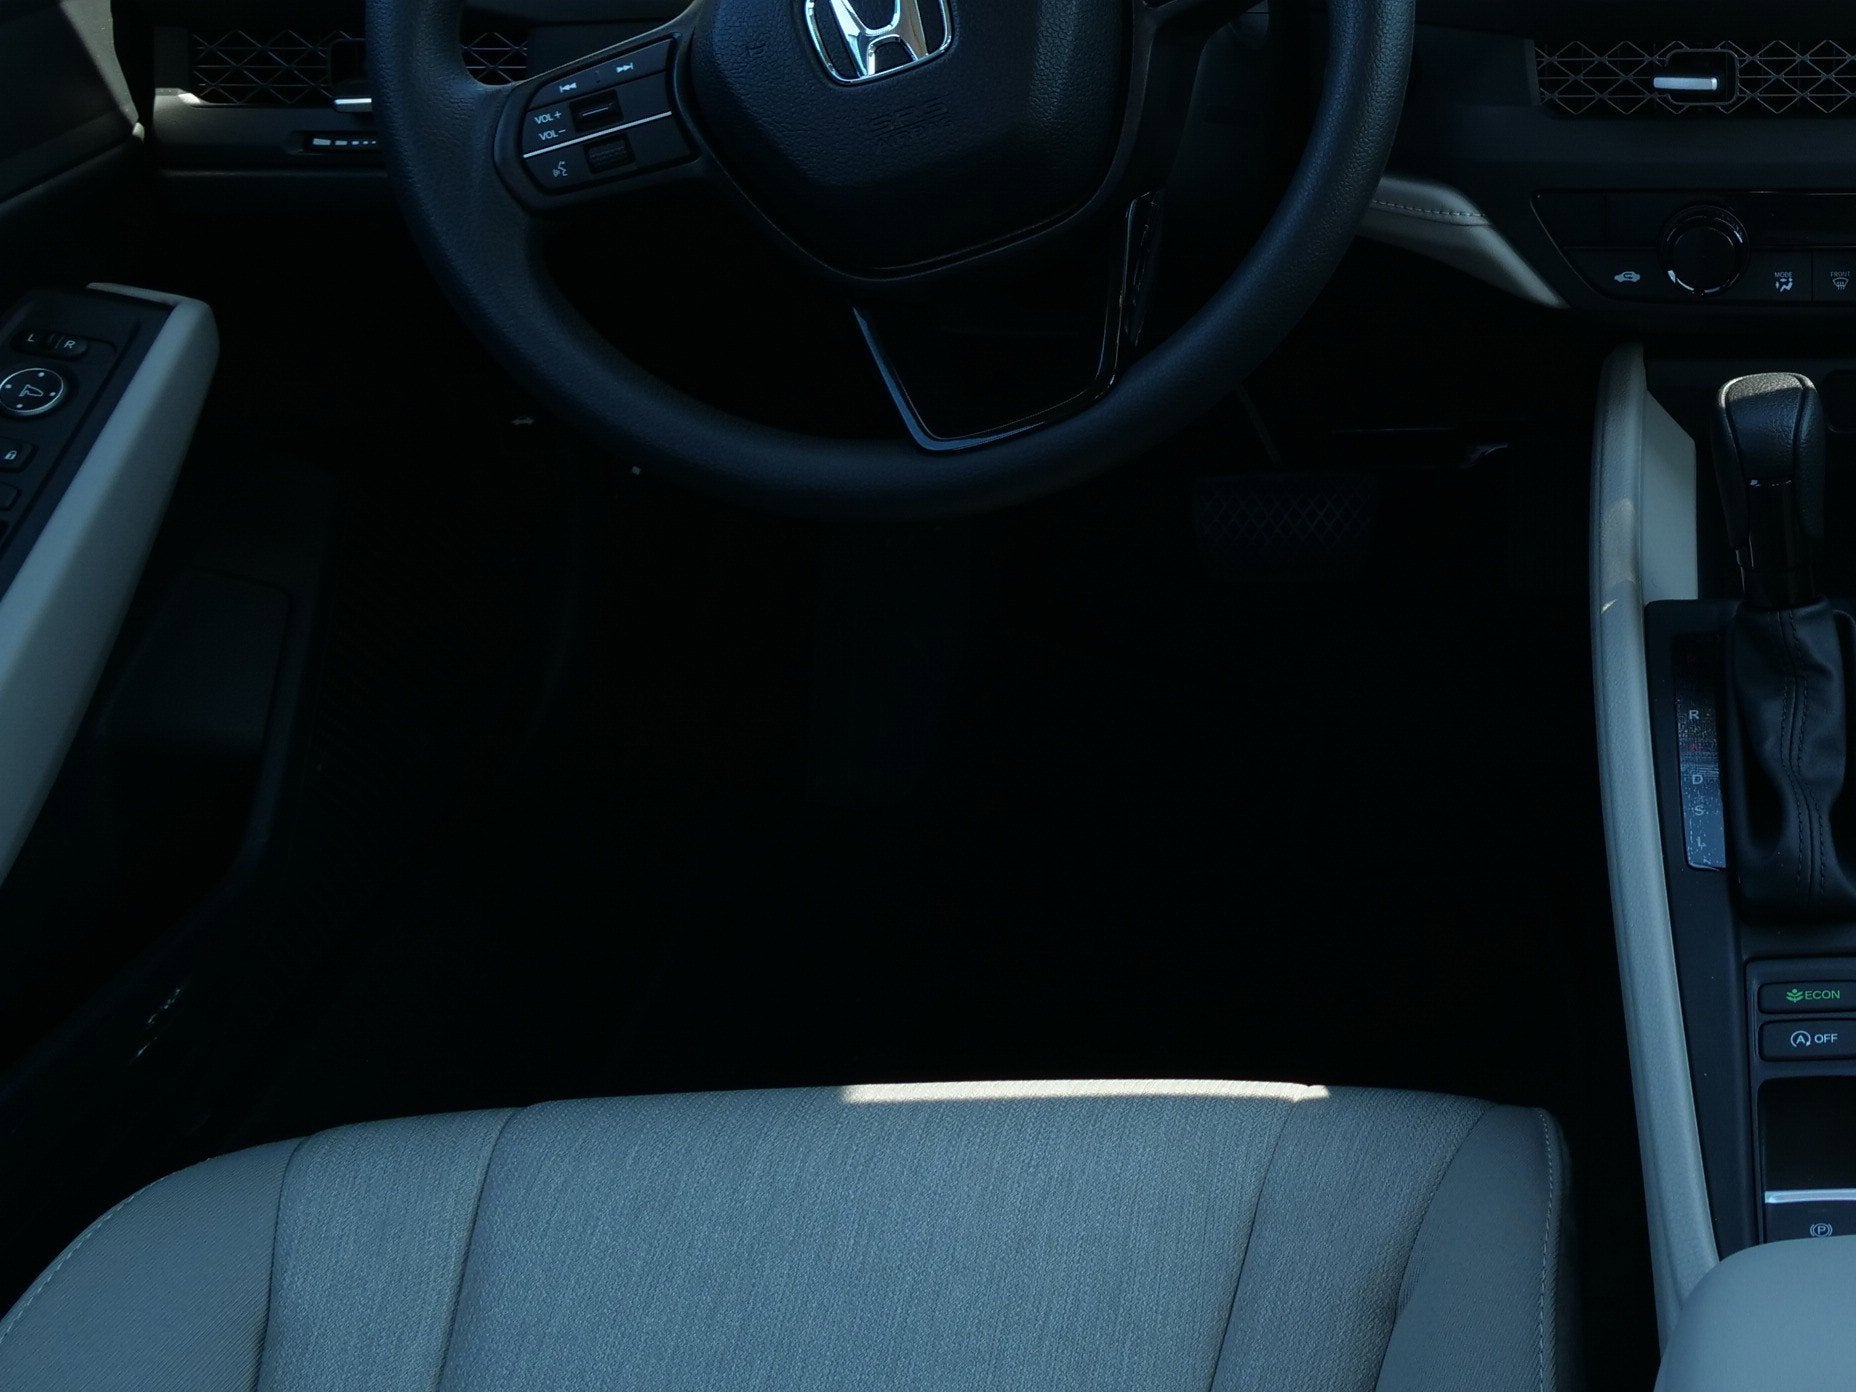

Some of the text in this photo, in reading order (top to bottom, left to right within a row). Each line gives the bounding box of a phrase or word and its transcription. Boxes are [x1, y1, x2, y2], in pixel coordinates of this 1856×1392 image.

[27, 333, 36, 343] L
[63, 339, 76, 349] R
[1689, 709, 1700, 720] R
[1692, 774, 1703, 785] D
[1694, 805, 1705, 816] S
[1697, 836, 1706, 847] L
[1805, 989, 1841, 1000] ECON
[1814, 1033, 1839, 1044] OFF
